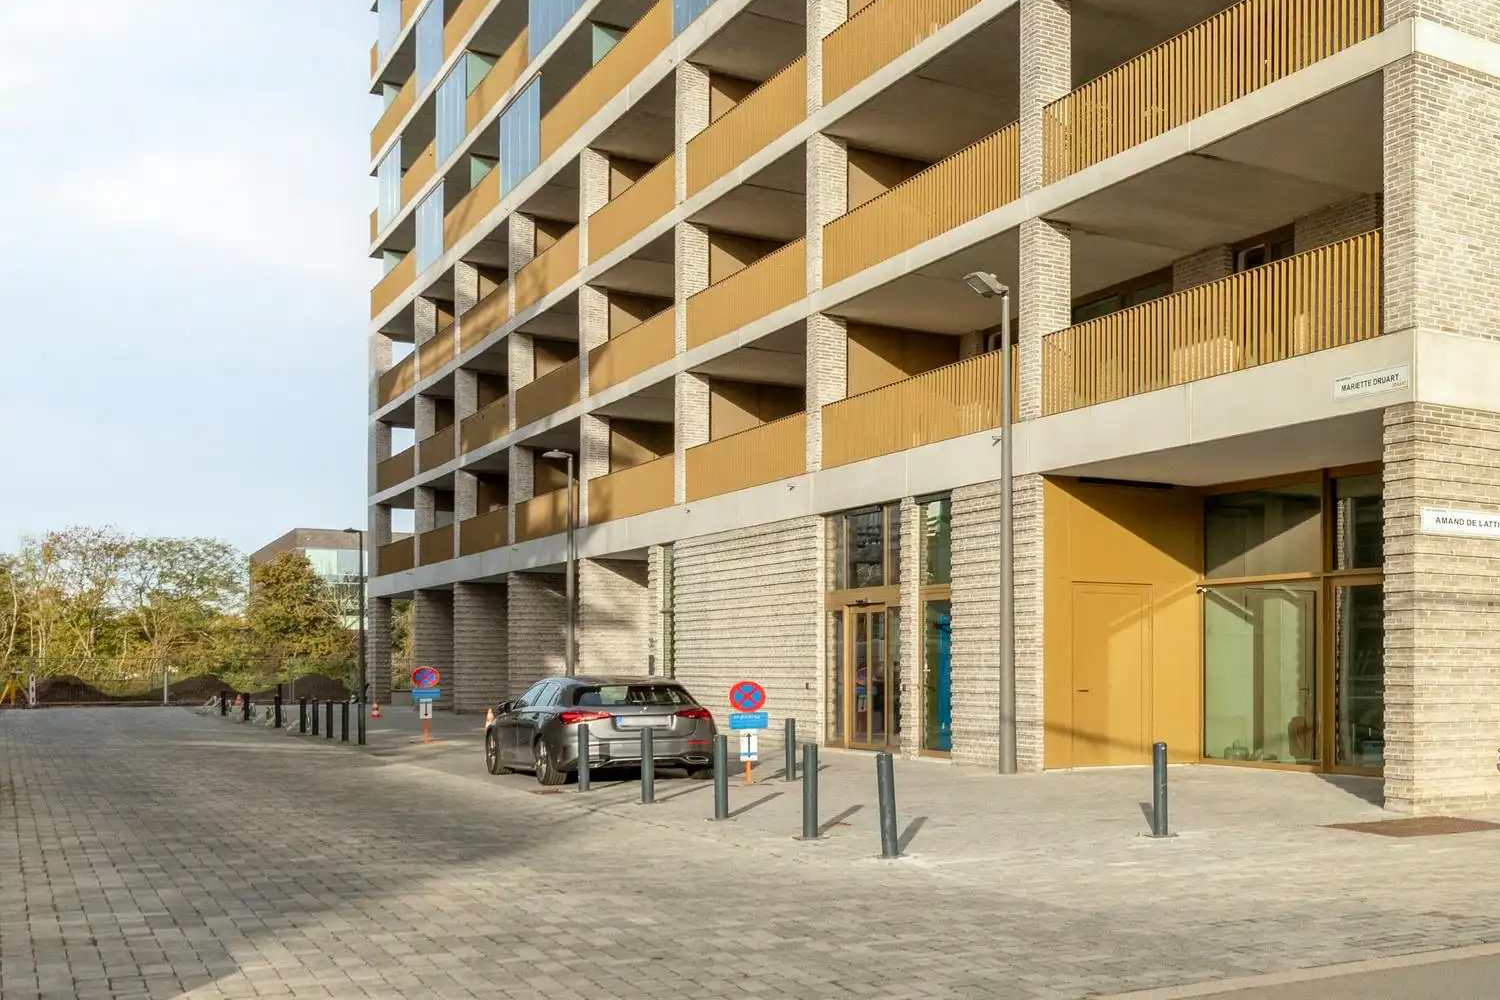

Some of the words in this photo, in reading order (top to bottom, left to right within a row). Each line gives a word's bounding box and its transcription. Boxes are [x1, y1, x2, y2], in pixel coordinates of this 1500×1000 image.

[1341, 379, 1372, 392] MARIETTE
[1373, 373, 1400, 386] DRUART
[1435, 516, 1465, 526] AMAND
[1466, 519, 1477, 527] DE
